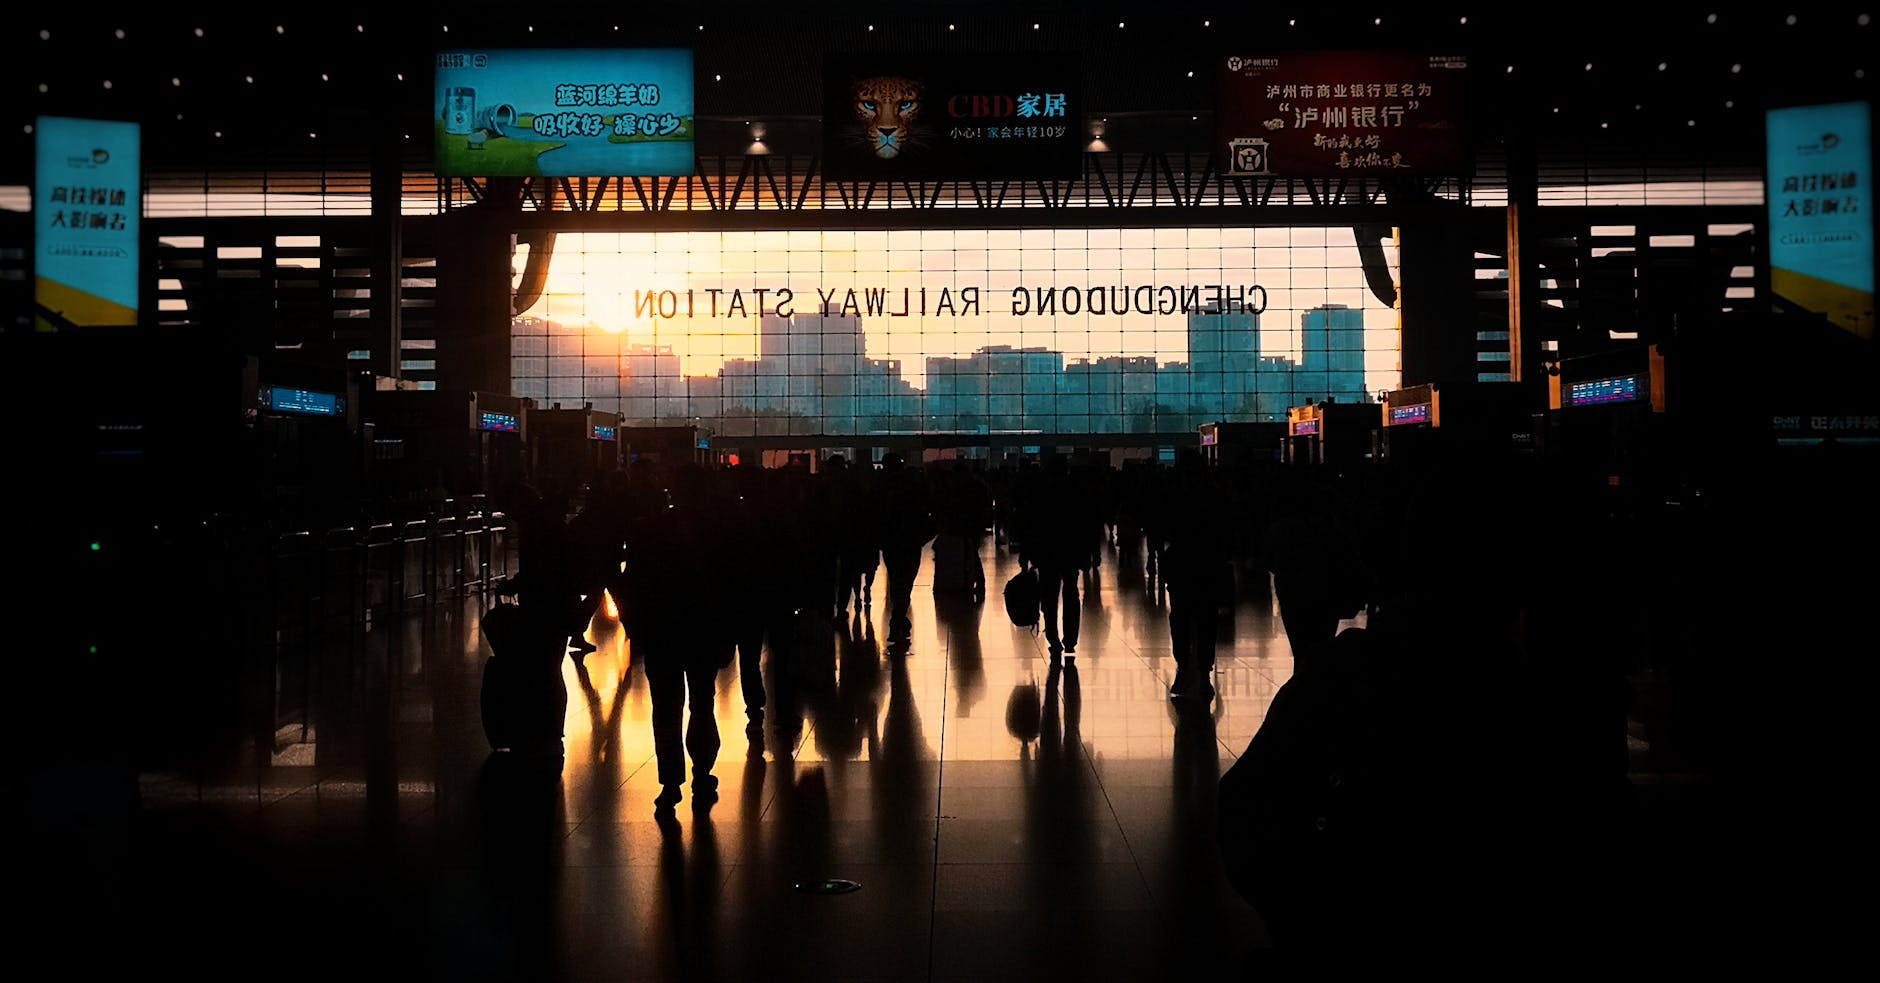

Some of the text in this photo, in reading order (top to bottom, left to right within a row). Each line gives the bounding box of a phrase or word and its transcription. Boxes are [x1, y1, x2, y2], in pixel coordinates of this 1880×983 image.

[556, 83, 660, 107] 蓝河绵羊奶
[1266, 82, 1432, 99] 泸州市商业银行更名为
[533, 112, 682, 137] 吸收好 操心少
